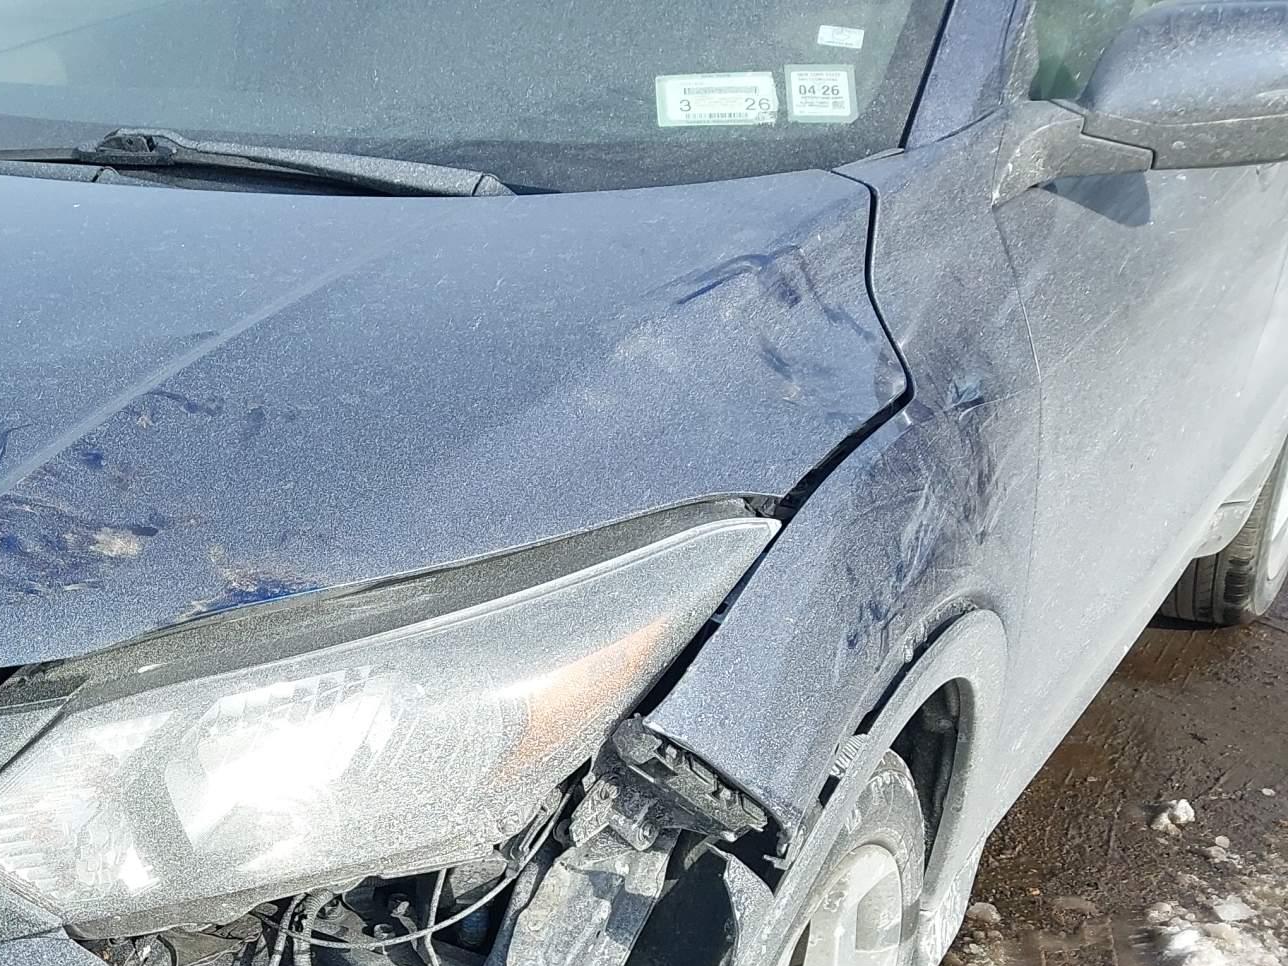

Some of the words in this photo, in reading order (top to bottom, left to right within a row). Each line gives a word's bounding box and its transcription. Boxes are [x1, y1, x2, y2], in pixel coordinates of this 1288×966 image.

[798, 84, 816, 96] 04
[821, 84, 840, 96] 26
[679, 99, 692, 112] 3
[744, 97, 771, 111] 26
